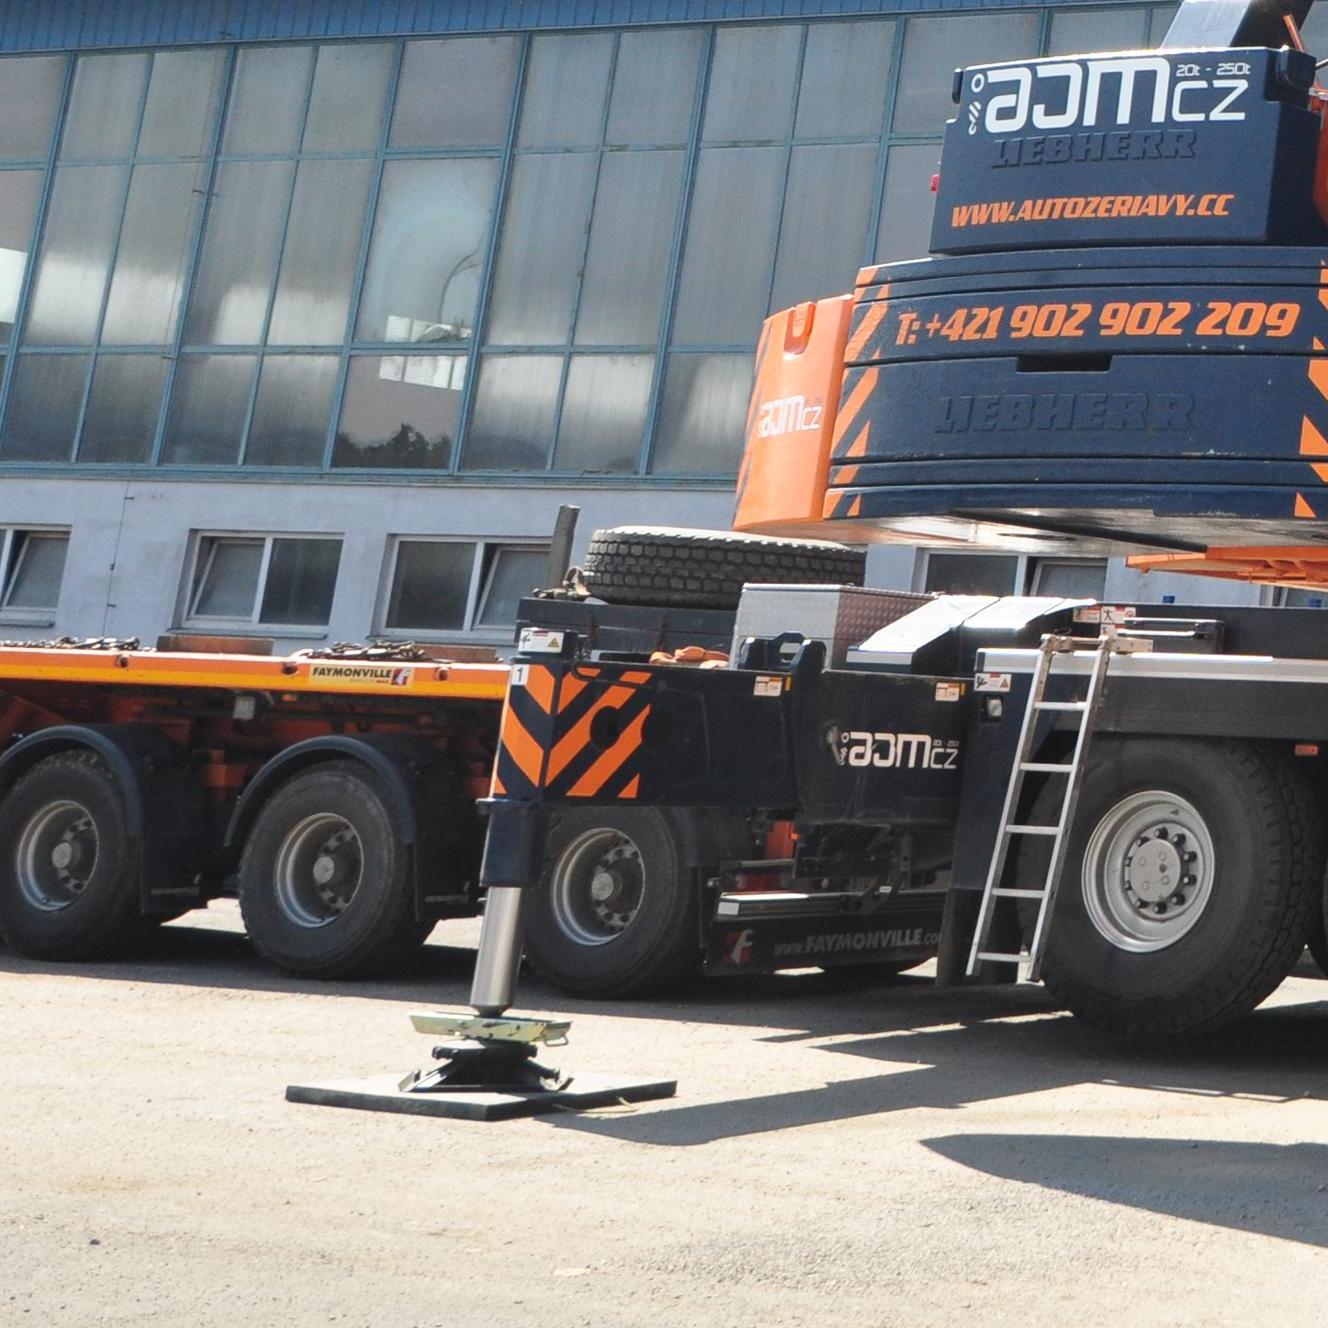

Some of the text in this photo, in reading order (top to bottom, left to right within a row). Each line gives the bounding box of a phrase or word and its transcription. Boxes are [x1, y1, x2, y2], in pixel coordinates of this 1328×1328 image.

[991, 129, 1197, 169] LIEBHERR
[952, 194, 1235, 227] WWW.AUTOZERIAVY.CC
[896, 301, 1300, 345] T: +421 902 902 209
[934, 393, 1196, 434] LIEBHERR
[312, 667, 393, 678] FAYMONVILLE
